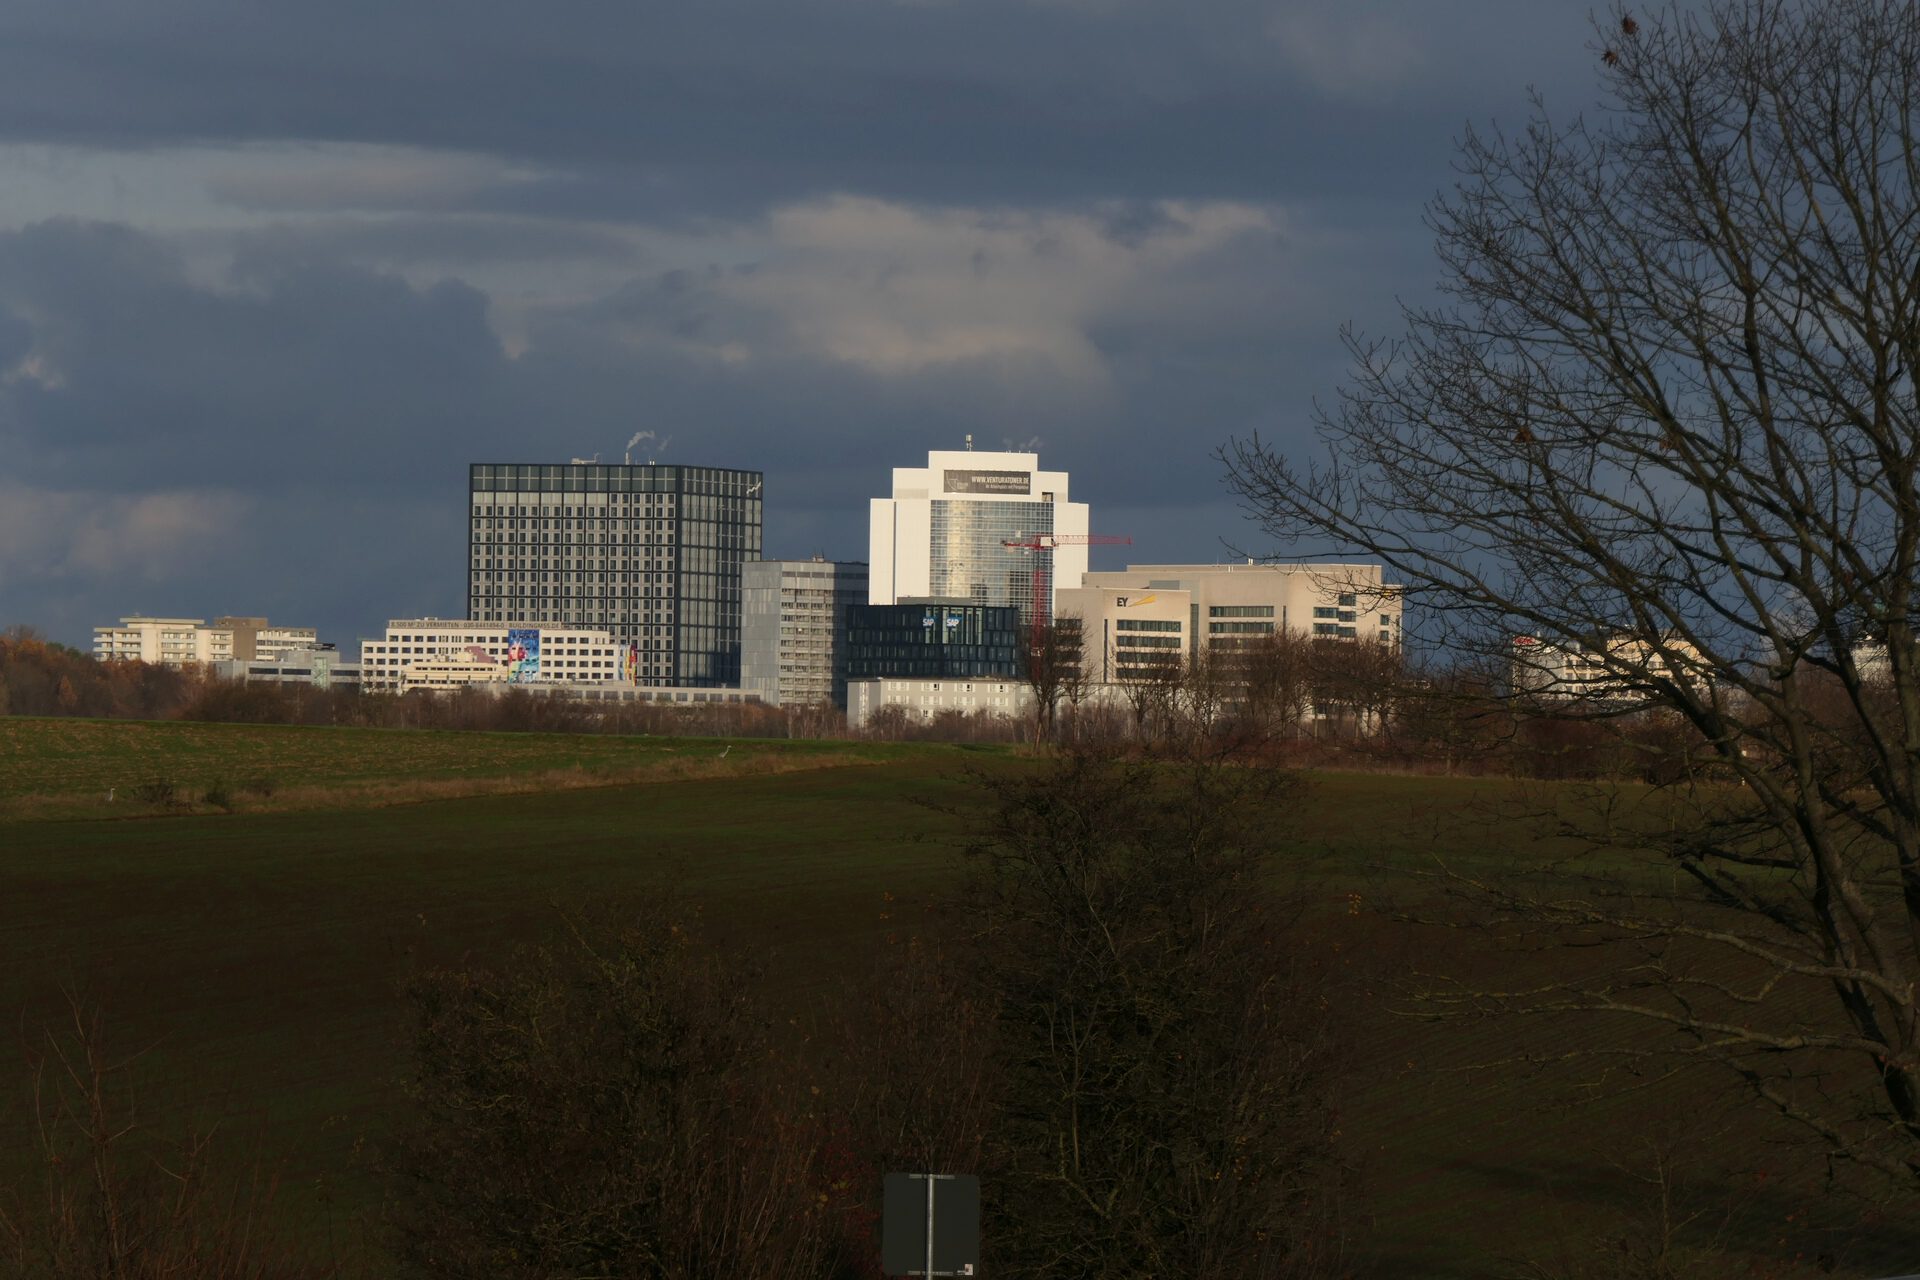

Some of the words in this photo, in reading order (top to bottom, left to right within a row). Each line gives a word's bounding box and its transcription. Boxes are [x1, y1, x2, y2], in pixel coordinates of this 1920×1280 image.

[1117, 597, 1128, 607] EY
[923, 618, 934, 626] SAP
[946, 618, 959, 626] SAP
